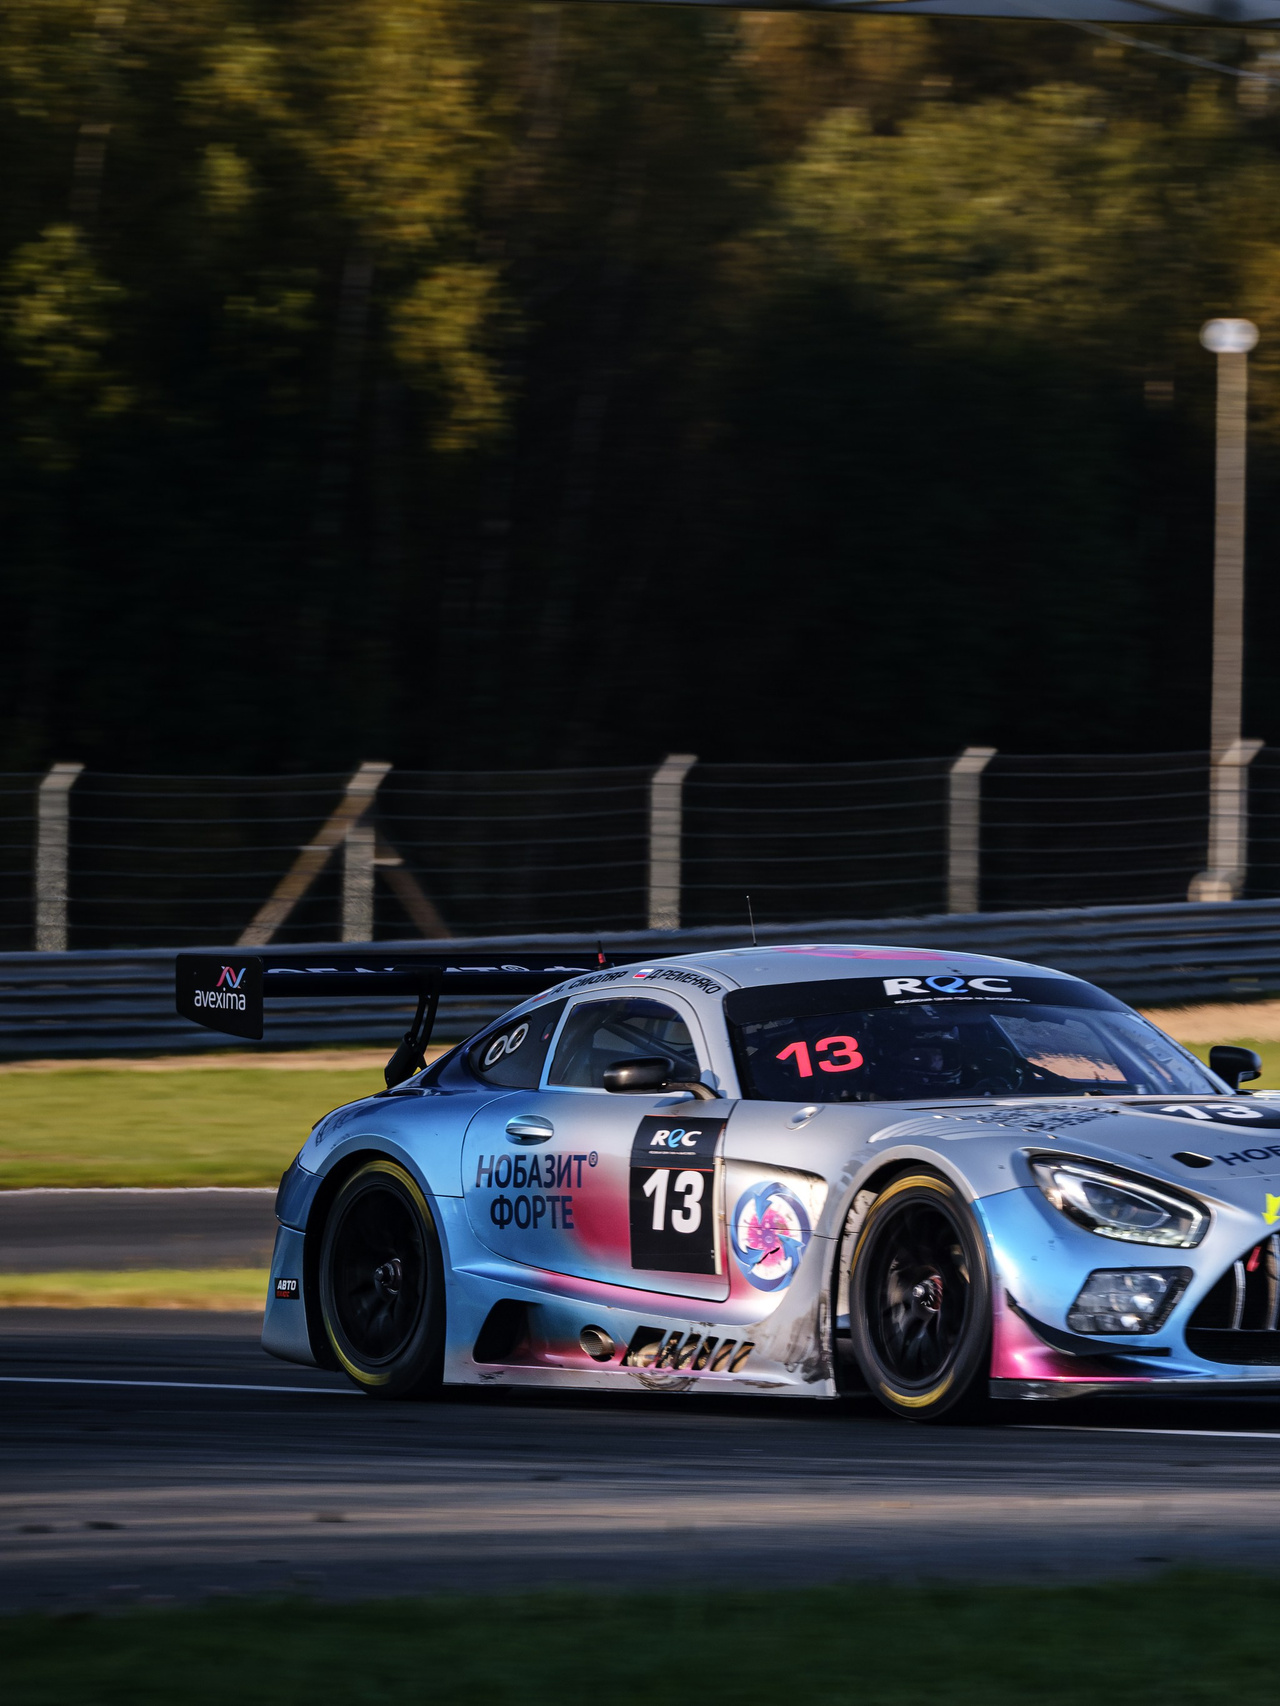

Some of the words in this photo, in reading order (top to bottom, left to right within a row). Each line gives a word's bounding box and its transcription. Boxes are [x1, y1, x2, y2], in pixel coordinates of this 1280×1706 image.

[194, 987, 246, 1011] avexima
[776, 1035, 864, 1078] 13
[1160, 1104, 1264, 1120] 13
[490, 1195, 574, 1230] ФОРТЕ
[642, 1168, 705, 1234] 13
[277, 1280, 297, 1291] АВТО
